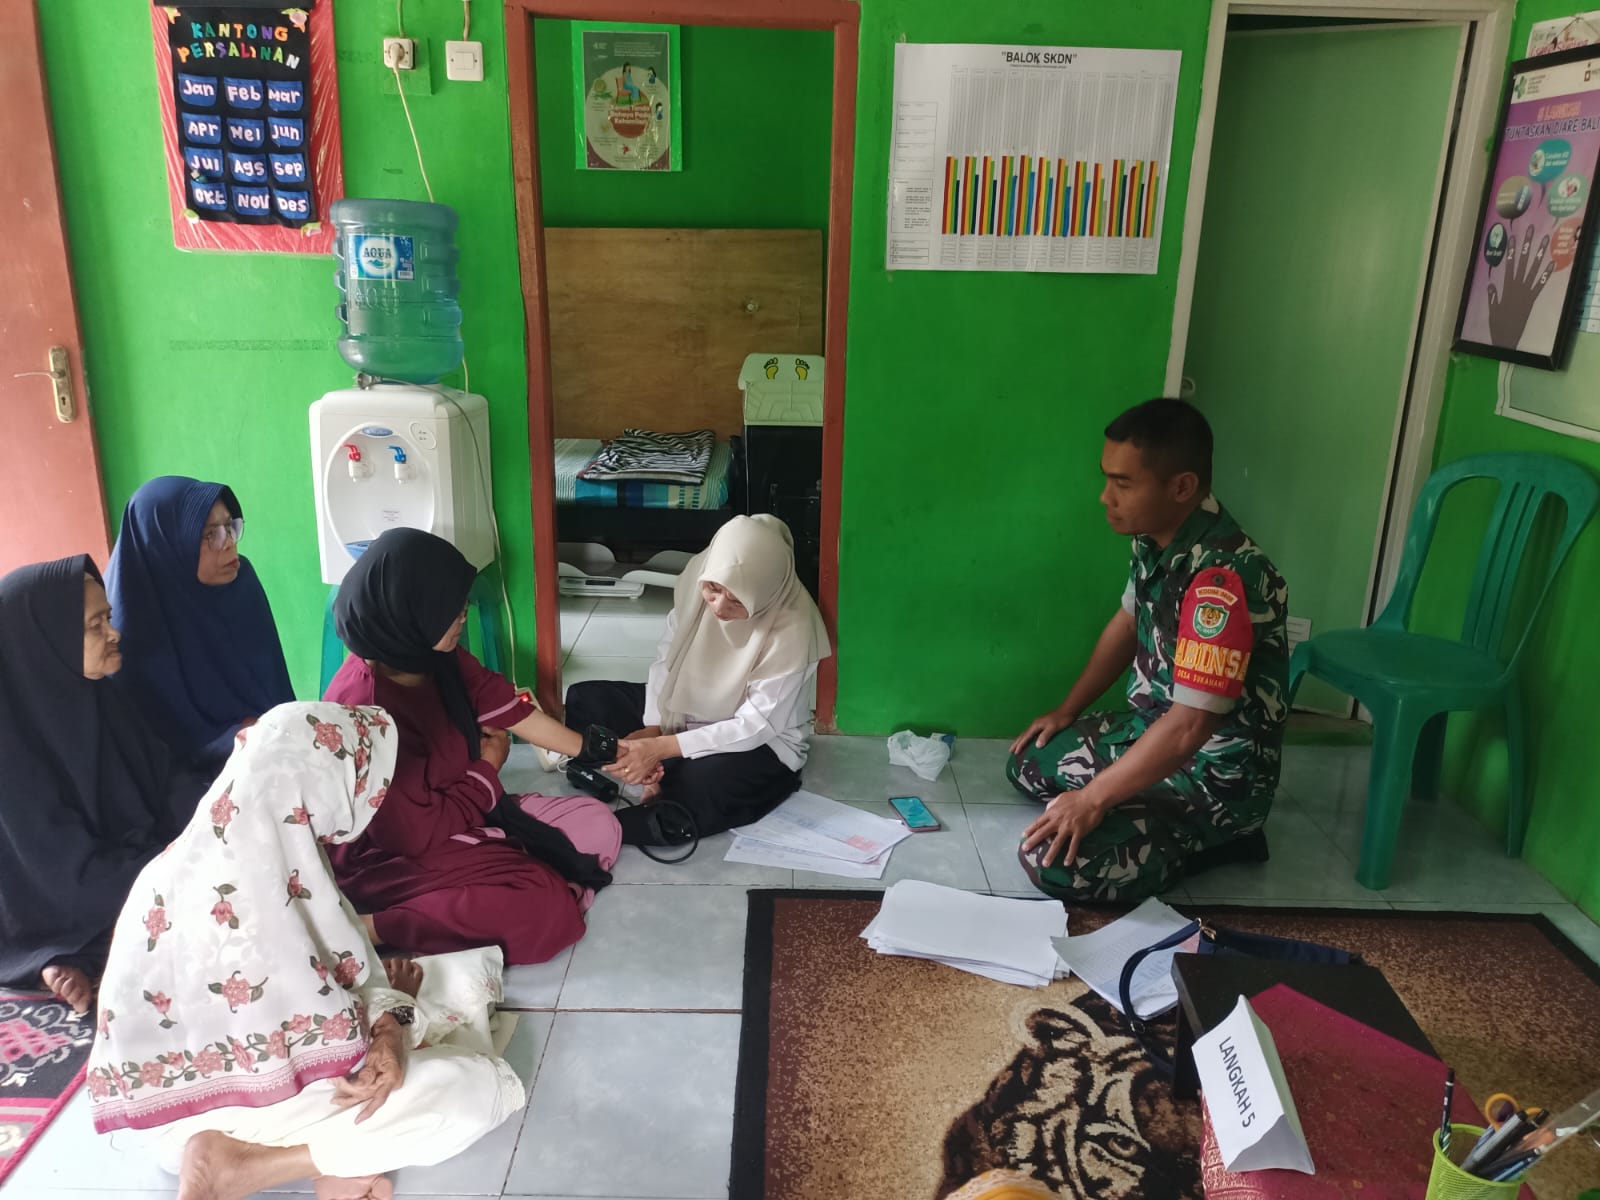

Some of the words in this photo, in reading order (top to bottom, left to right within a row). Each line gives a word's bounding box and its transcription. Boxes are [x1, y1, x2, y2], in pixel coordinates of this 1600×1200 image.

[191, 22, 288, 41] KANTONG
[178, 41, 300, 69] PERSALINAN
[183, 80, 214, 97] Jan
[227, 86, 261, 102] Feb
[268, 89, 300, 104] Mar
[272, 124, 300, 141] Jun
[234, 160, 265, 176] Ags
[363, 247, 393, 259] AQUA
[1507, 248, 1515, 260] 2
[1522, 242, 1530, 255] 3
[1536, 247, 1544, 258] 4
[1540, 271, 1549, 284] 5
[1219, 1036, 1252, 1115] LANGKAH
[1242, 1111, 1256, 1128] 5
